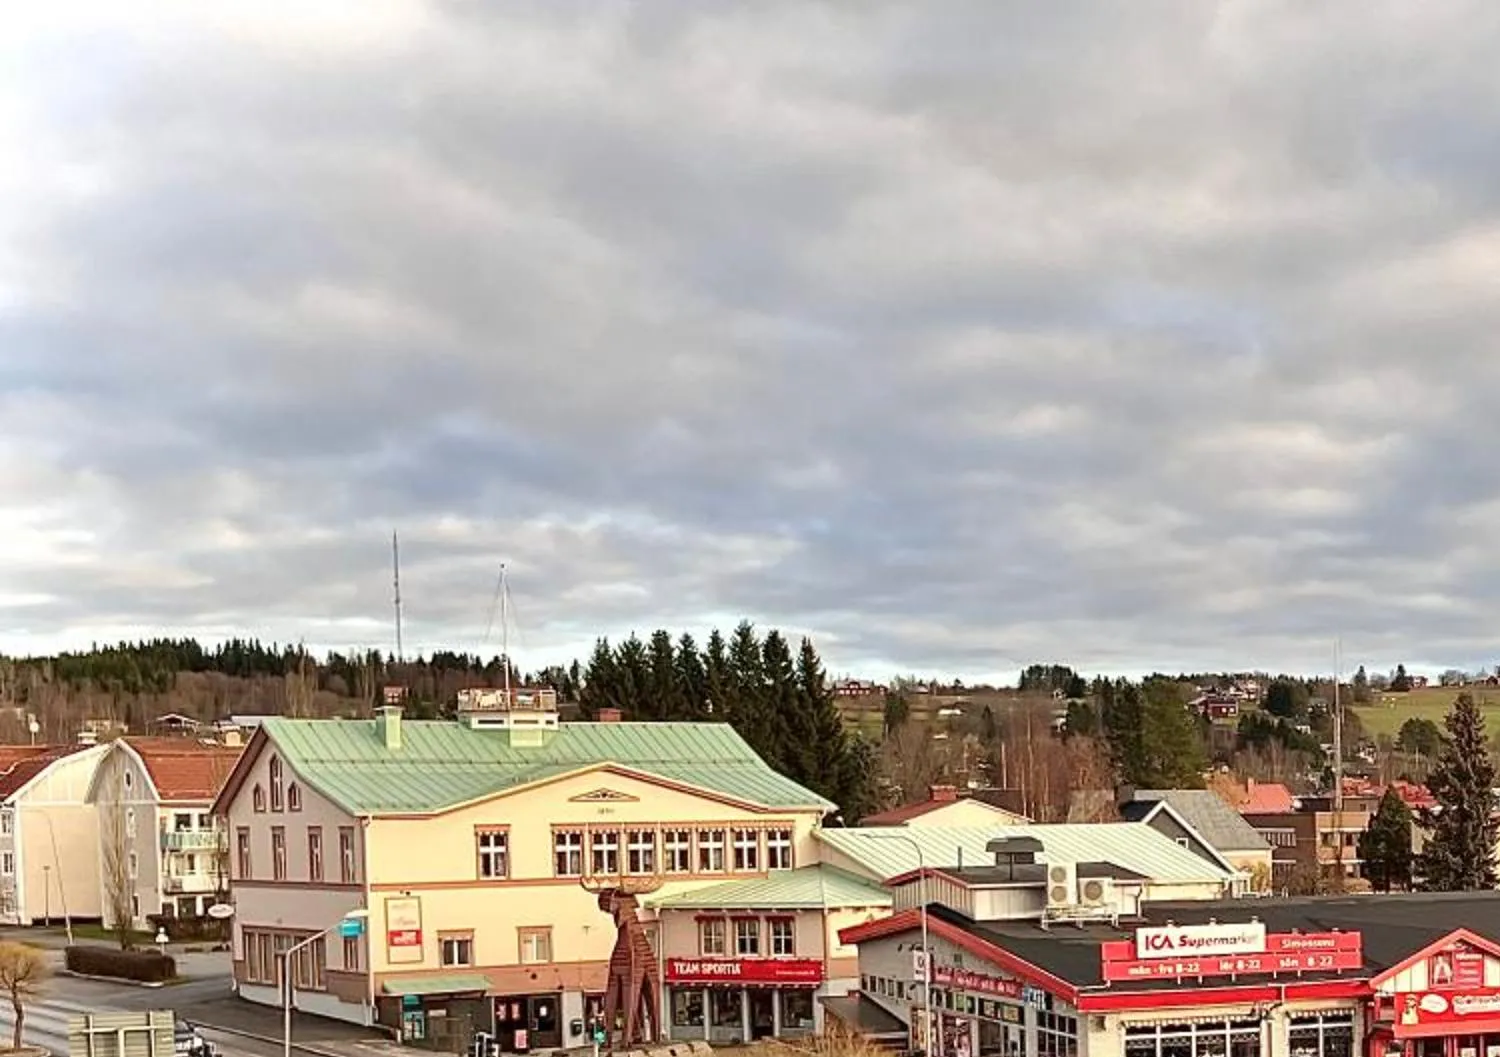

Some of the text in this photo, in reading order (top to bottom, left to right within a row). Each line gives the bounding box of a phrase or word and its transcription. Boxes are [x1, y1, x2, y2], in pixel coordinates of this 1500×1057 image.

[1145, 934, 1174, 951] ICA
[674, 962, 741, 974] TEAM SPORTIA
